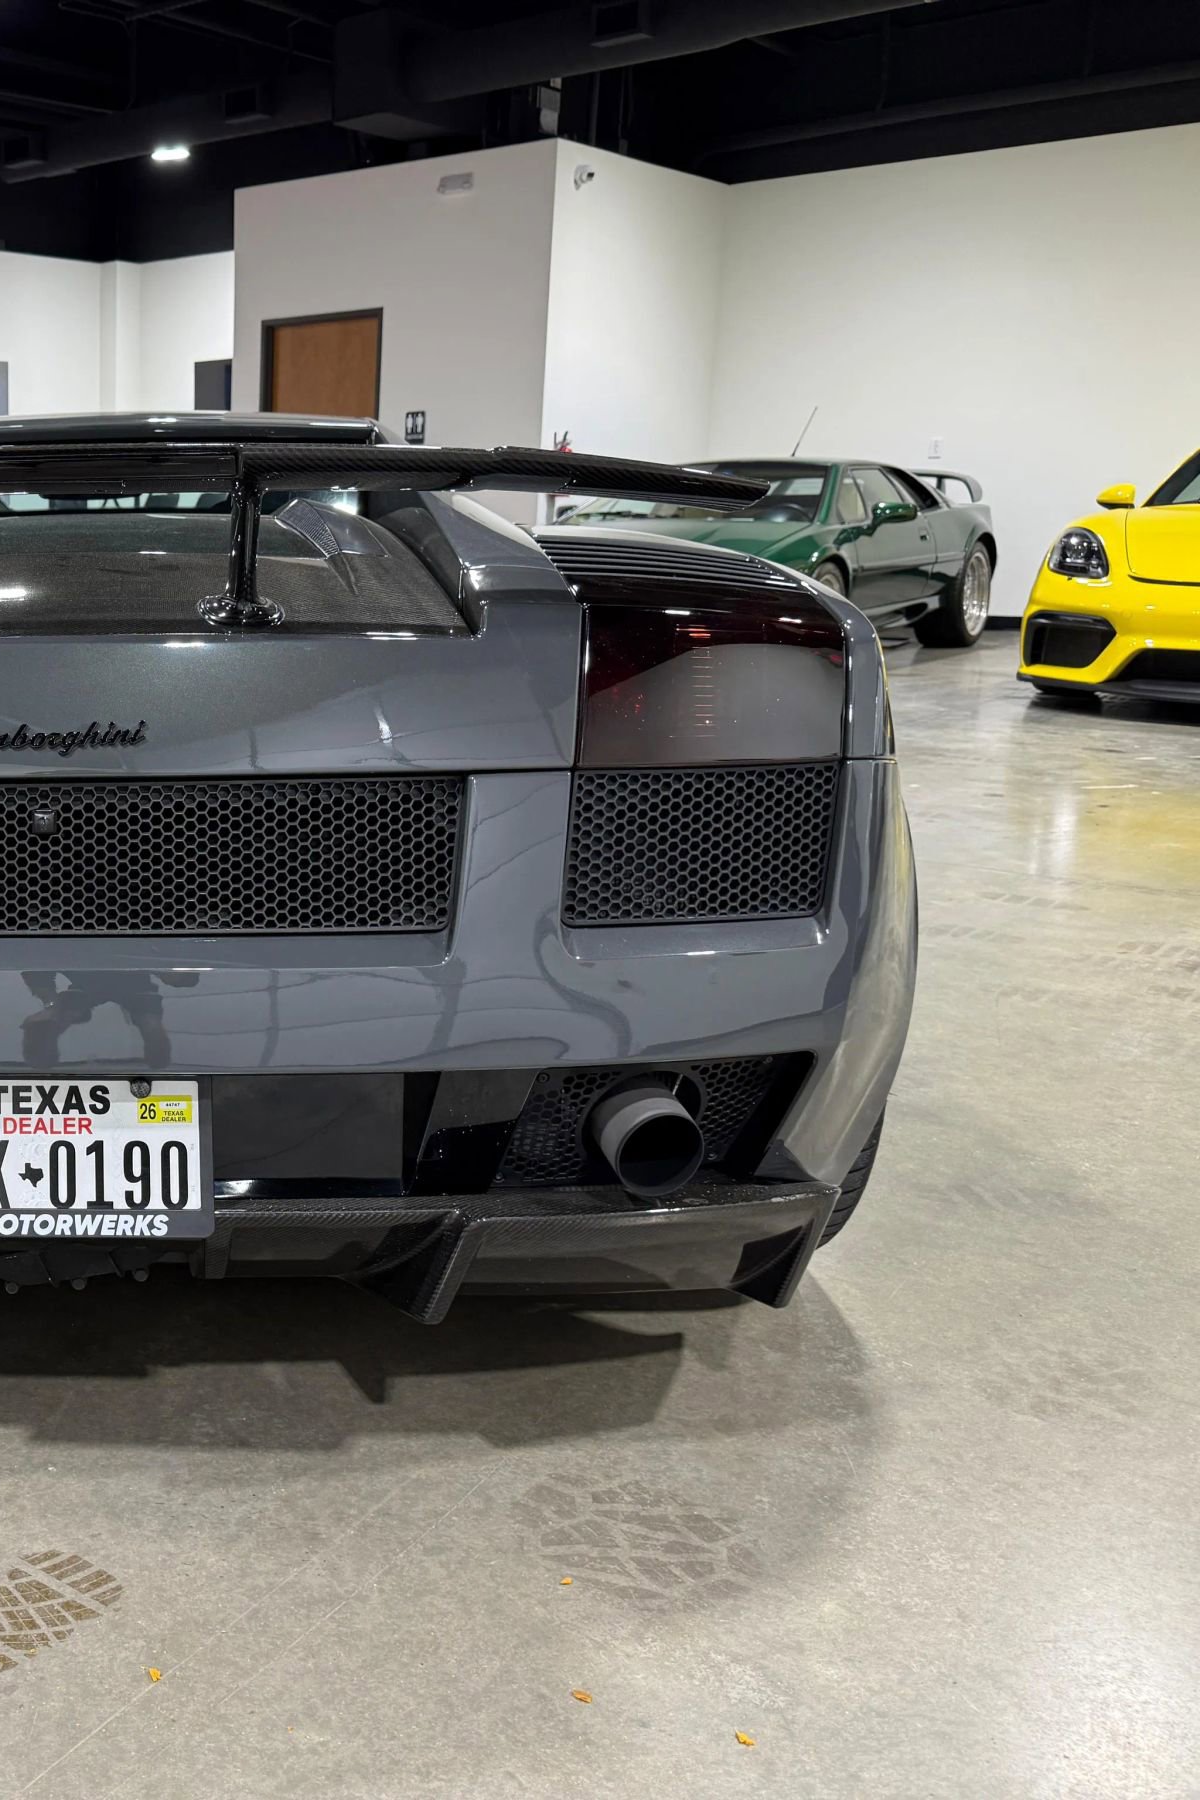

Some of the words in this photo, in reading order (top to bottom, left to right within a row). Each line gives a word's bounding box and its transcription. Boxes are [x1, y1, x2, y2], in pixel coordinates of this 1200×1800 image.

[140, 1103, 157, 1120] 26
[3, 1117, 93, 1134] DEALER
[50, 1140, 189, 1209] 0190
